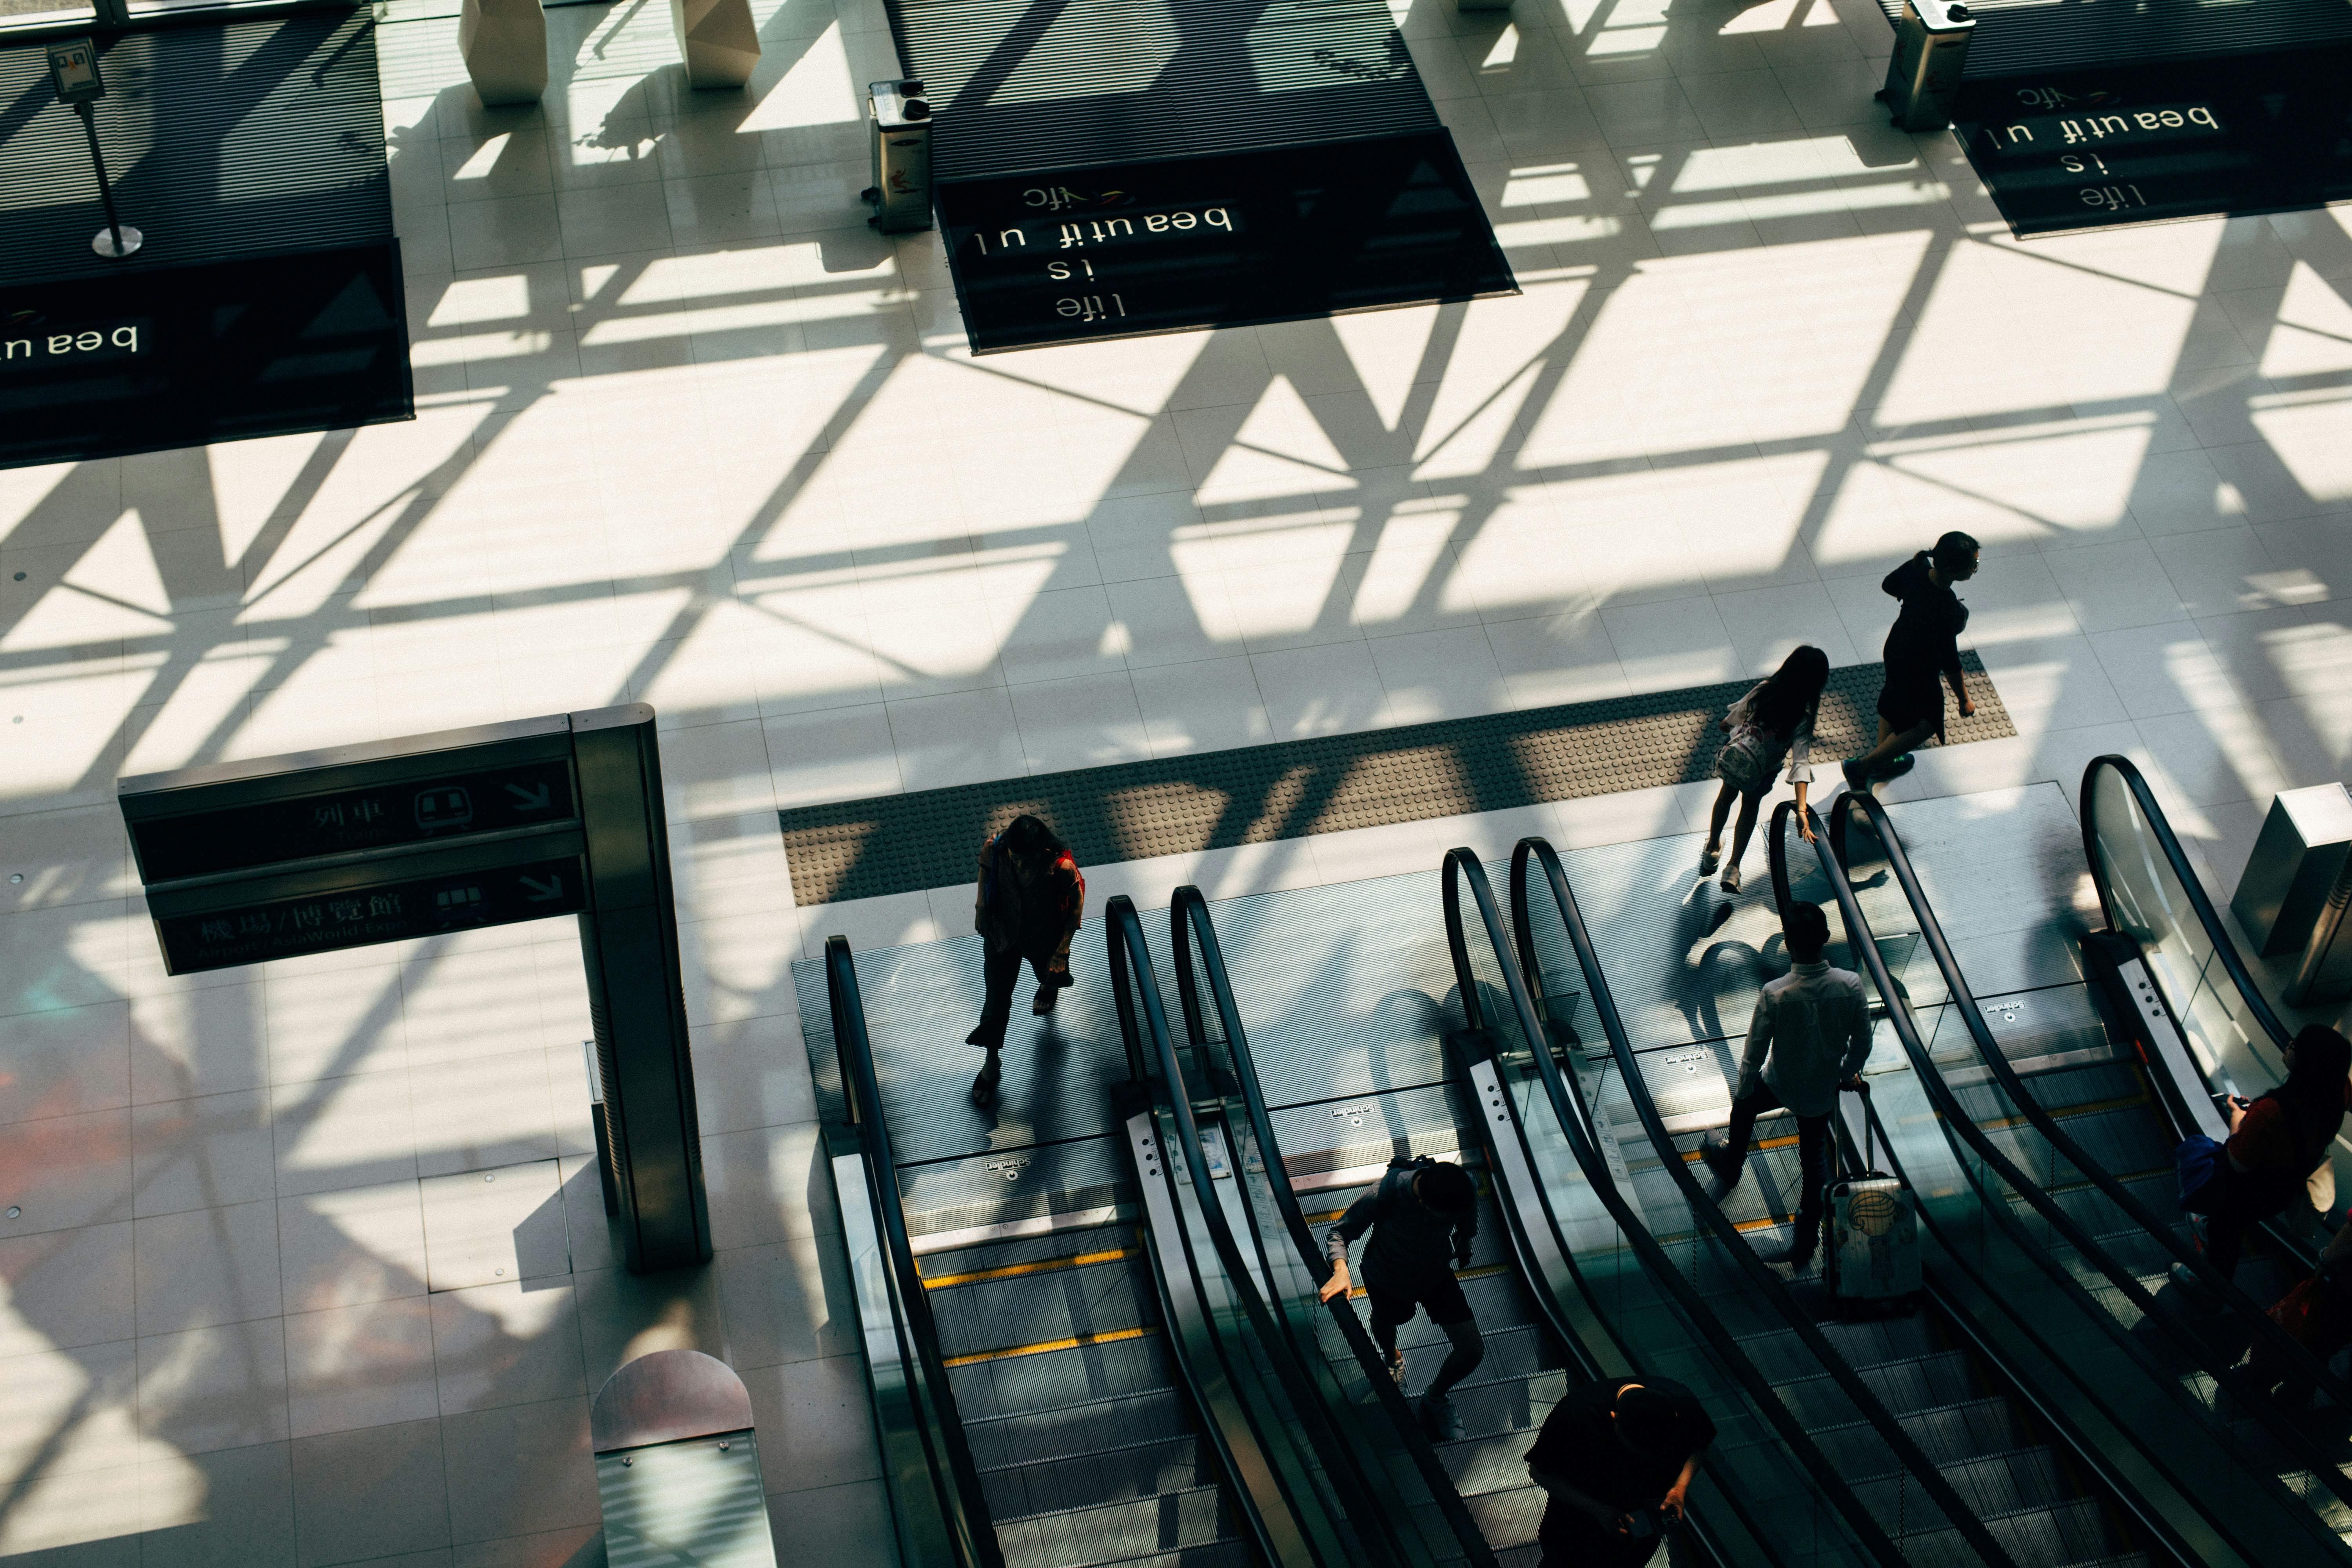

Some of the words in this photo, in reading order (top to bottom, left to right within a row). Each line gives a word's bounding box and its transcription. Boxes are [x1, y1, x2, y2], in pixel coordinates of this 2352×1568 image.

[2060, 153, 2109, 175] is
[2079, 184, 2147, 211] life
[1047, 259, 1094, 281] is
[1056, 293, 1126, 322] life
[0, 326, 137, 360] beau
[312, 799, 385, 828] 列車
[336, 828, 388, 842] Trains
[198, 941, 259, 960] Airport
[272, 919, 409, 949] AsiaWorld-Expo
[1986, 1000, 2024, 1013] Schindler
[1667, 1052, 1707, 1064] Schindler
[1333, 1104, 1374, 1116] Schindler
[987, 1158, 1031, 1171] Schindler
